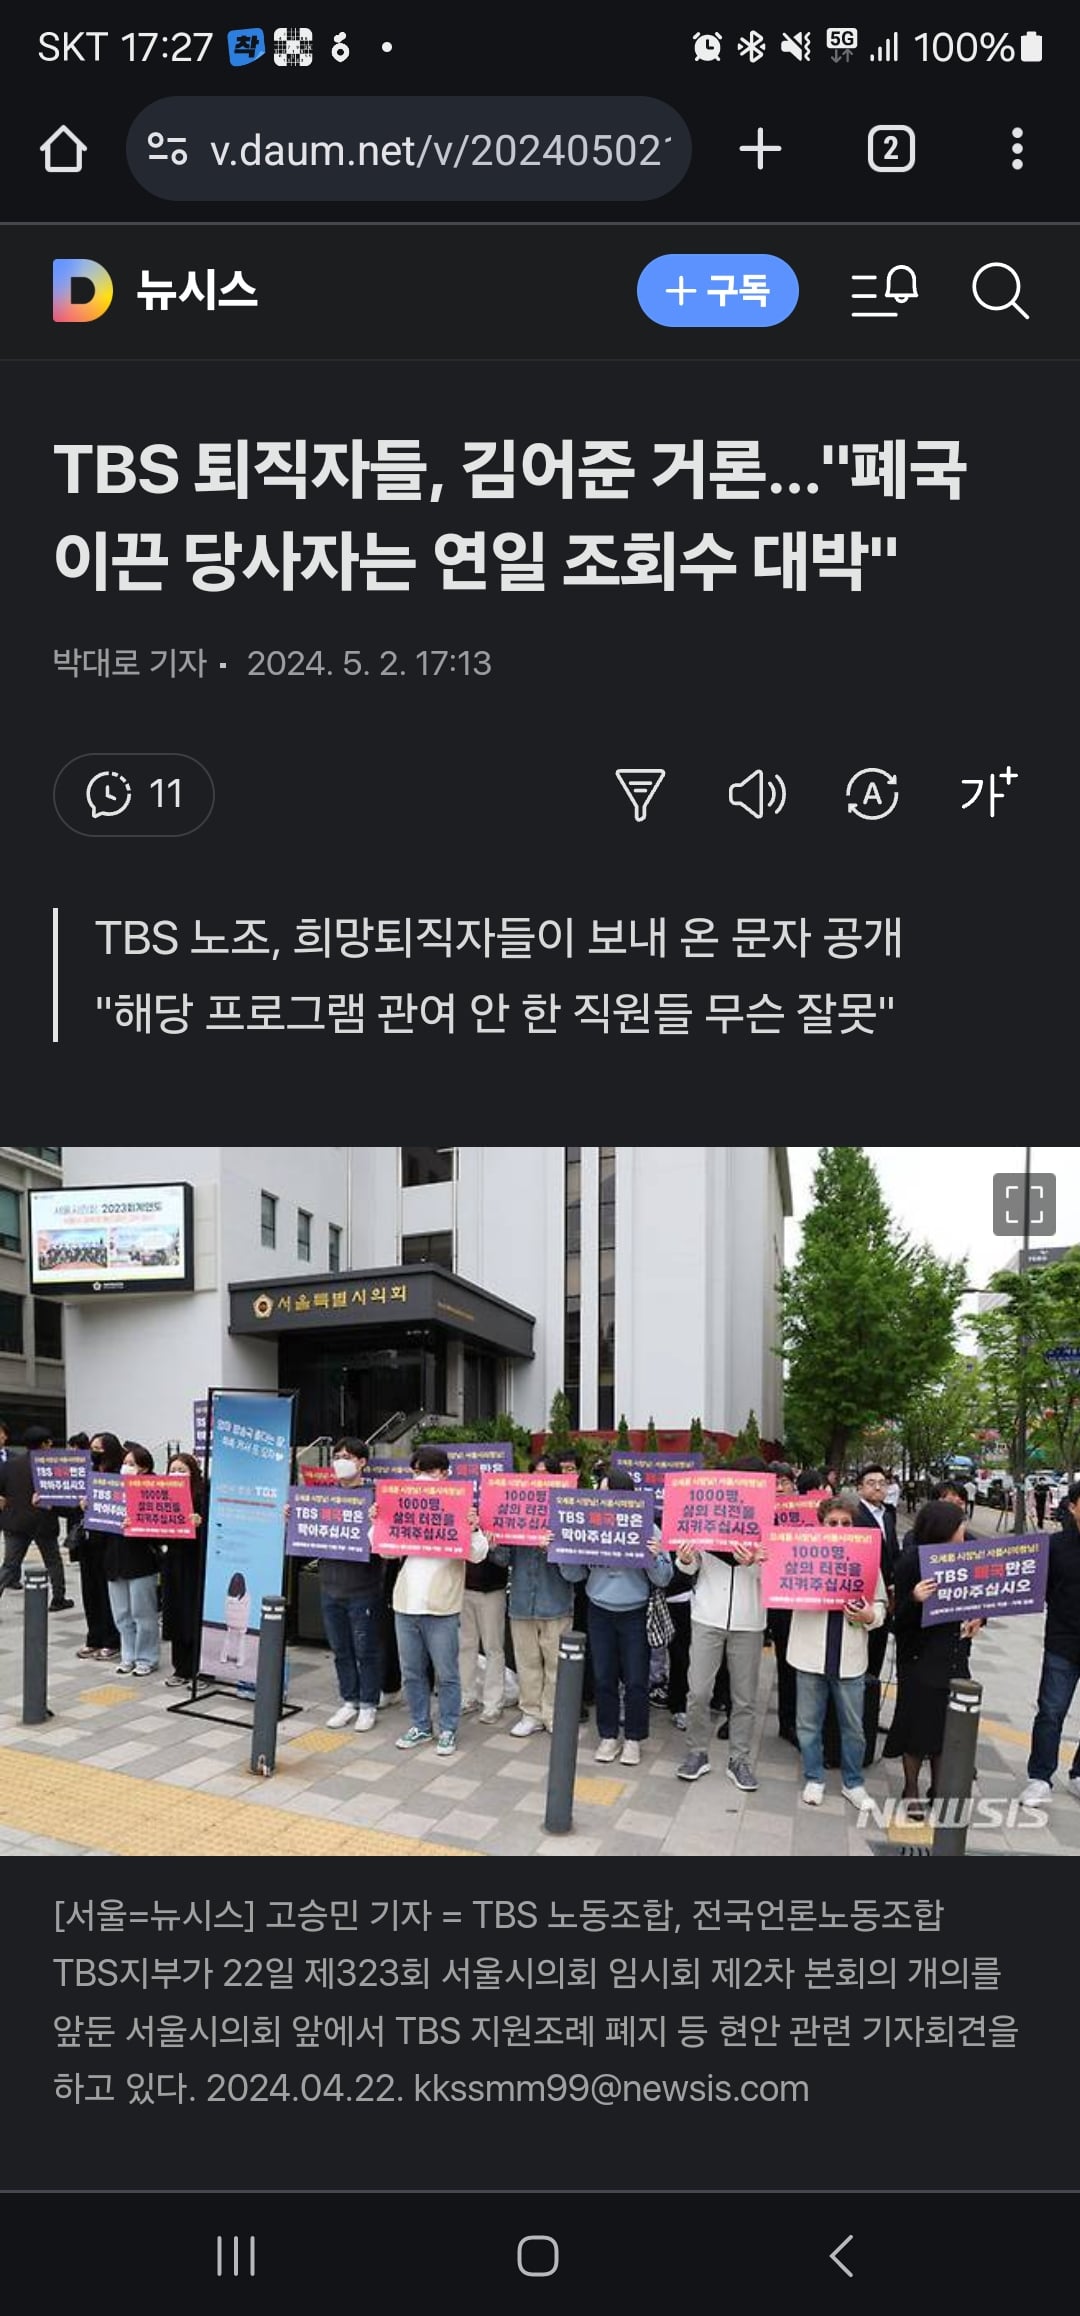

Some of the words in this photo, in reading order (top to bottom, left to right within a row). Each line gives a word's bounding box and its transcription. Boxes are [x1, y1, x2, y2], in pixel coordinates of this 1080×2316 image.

[39, 32, 108, 62] SKT
[122, 32, 213, 62] 17:27
[830, 30, 855, 45] 5G
[914, 31, 1016, 63] 100%
[210, 133, 672, 169] v.daum.net/v/20240502
[883, 135, 899, 160] 2
[137, 269, 259, 312] 뉴시스
[707, 274, 771, 308] 구독
[54, 444, 179, 494] TBS
[194, 439, 444, 503] 퇴직자들,
[462, 439, 636, 500] 김어준
[56, 531, 169, 592] 이끈
[186, 531, 417, 593] 당사자는
[435, 531, 546, 592] 연일
[563, 531, 738, 592] 조회수
[754, 531, 897, 593] 대박"
[54, 648, 141, 679] 박대로
[150, 648, 208, 679] 기자
[248, 650, 333, 676] 2024.
[344, 650, 370, 676] 5.
[381, 650, 406, 676] 2.
[417, 650, 492, 676] 17:13
[150, 779, 181, 808] 11
[95, 920, 179, 956] TBS
[191, 920, 280, 961] 노조,
[294, 917, 573, 959] 희망퇴직자들이
[589, 917, 666, 959] 보내
[681, 918, 719, 958] 온
[732, 917, 812, 959] 문자
[824, 917, 901, 960] 공개
[97, 993, 194, 1035] "해당
[206, 993, 364, 1034] 프로그램
[378, 993, 455, 1035] 관여
[471, 993, 511, 1034] 안
[522, 993, 562, 1034] 한
[574, 993, 693, 1035] 직원들
[706, 994, 785, 1035] 무슨
[797, 993, 894, 1035] 잘못"
[277, 1285, 407, 1313] 서울특별시의회
[296, 1508, 318, 1521] TBS
[558, 1510, 585, 1524] TBS
[561, 1529, 640, 1545] 막아주십시오
[792, 1546, 850, 1561] 1000명,
[820, 1562, 862, 1577] 터전을
[934, 1568, 969, 1584] TBS
[937, 1580, 1031, 1602] 막아주십시오
[56, 1899, 254, 1933] [서울=뉴시스]
[266, 1899, 358, 1933] 고승민
[371, 1899, 433, 1932] 기자
[473, 1901, 538, 1929] TBS
[548, 1899, 681, 1934] 노동조합,
[693, 1899, 945, 1933] 전국언론노동조합
[53, 1957, 214, 1990] TBS지부가
[224, 1957, 294, 1990] 22일
[305, 1957, 429, 1990] 제323회
[442, 1957, 596, 1990] 서울시의회
[610, 1957, 700, 1990] 임시회
[712, 1957, 796, 1990] 제2차
[805, 1957, 896, 1990] 본회의
[908, 1957, 1002, 1991] 개의를
[54, 2015, 116, 2048] 앞둔
[126, 2015, 280, 2048] 서울시의회
[293, 2015, 384, 2048] 앞에서
[396, 2016, 461, 2045] TBS
[471, 2015, 594, 2048] 지원조례
[606, 2015, 666, 2048] 폐지
[678, 2015, 708, 2049] 등
[720, 2015, 781, 2047] 현안
[790, 2015, 851, 2047] 관련
[864, 2015, 1019, 2048] 기자회견을
[54, 2073, 115, 2105] 하고
[127, 2073, 196, 2105] 있다.
[208, 2073, 403, 2102] 2024.04.22.
[416, 2073, 809, 2106] kkssmm99@newsis.com
